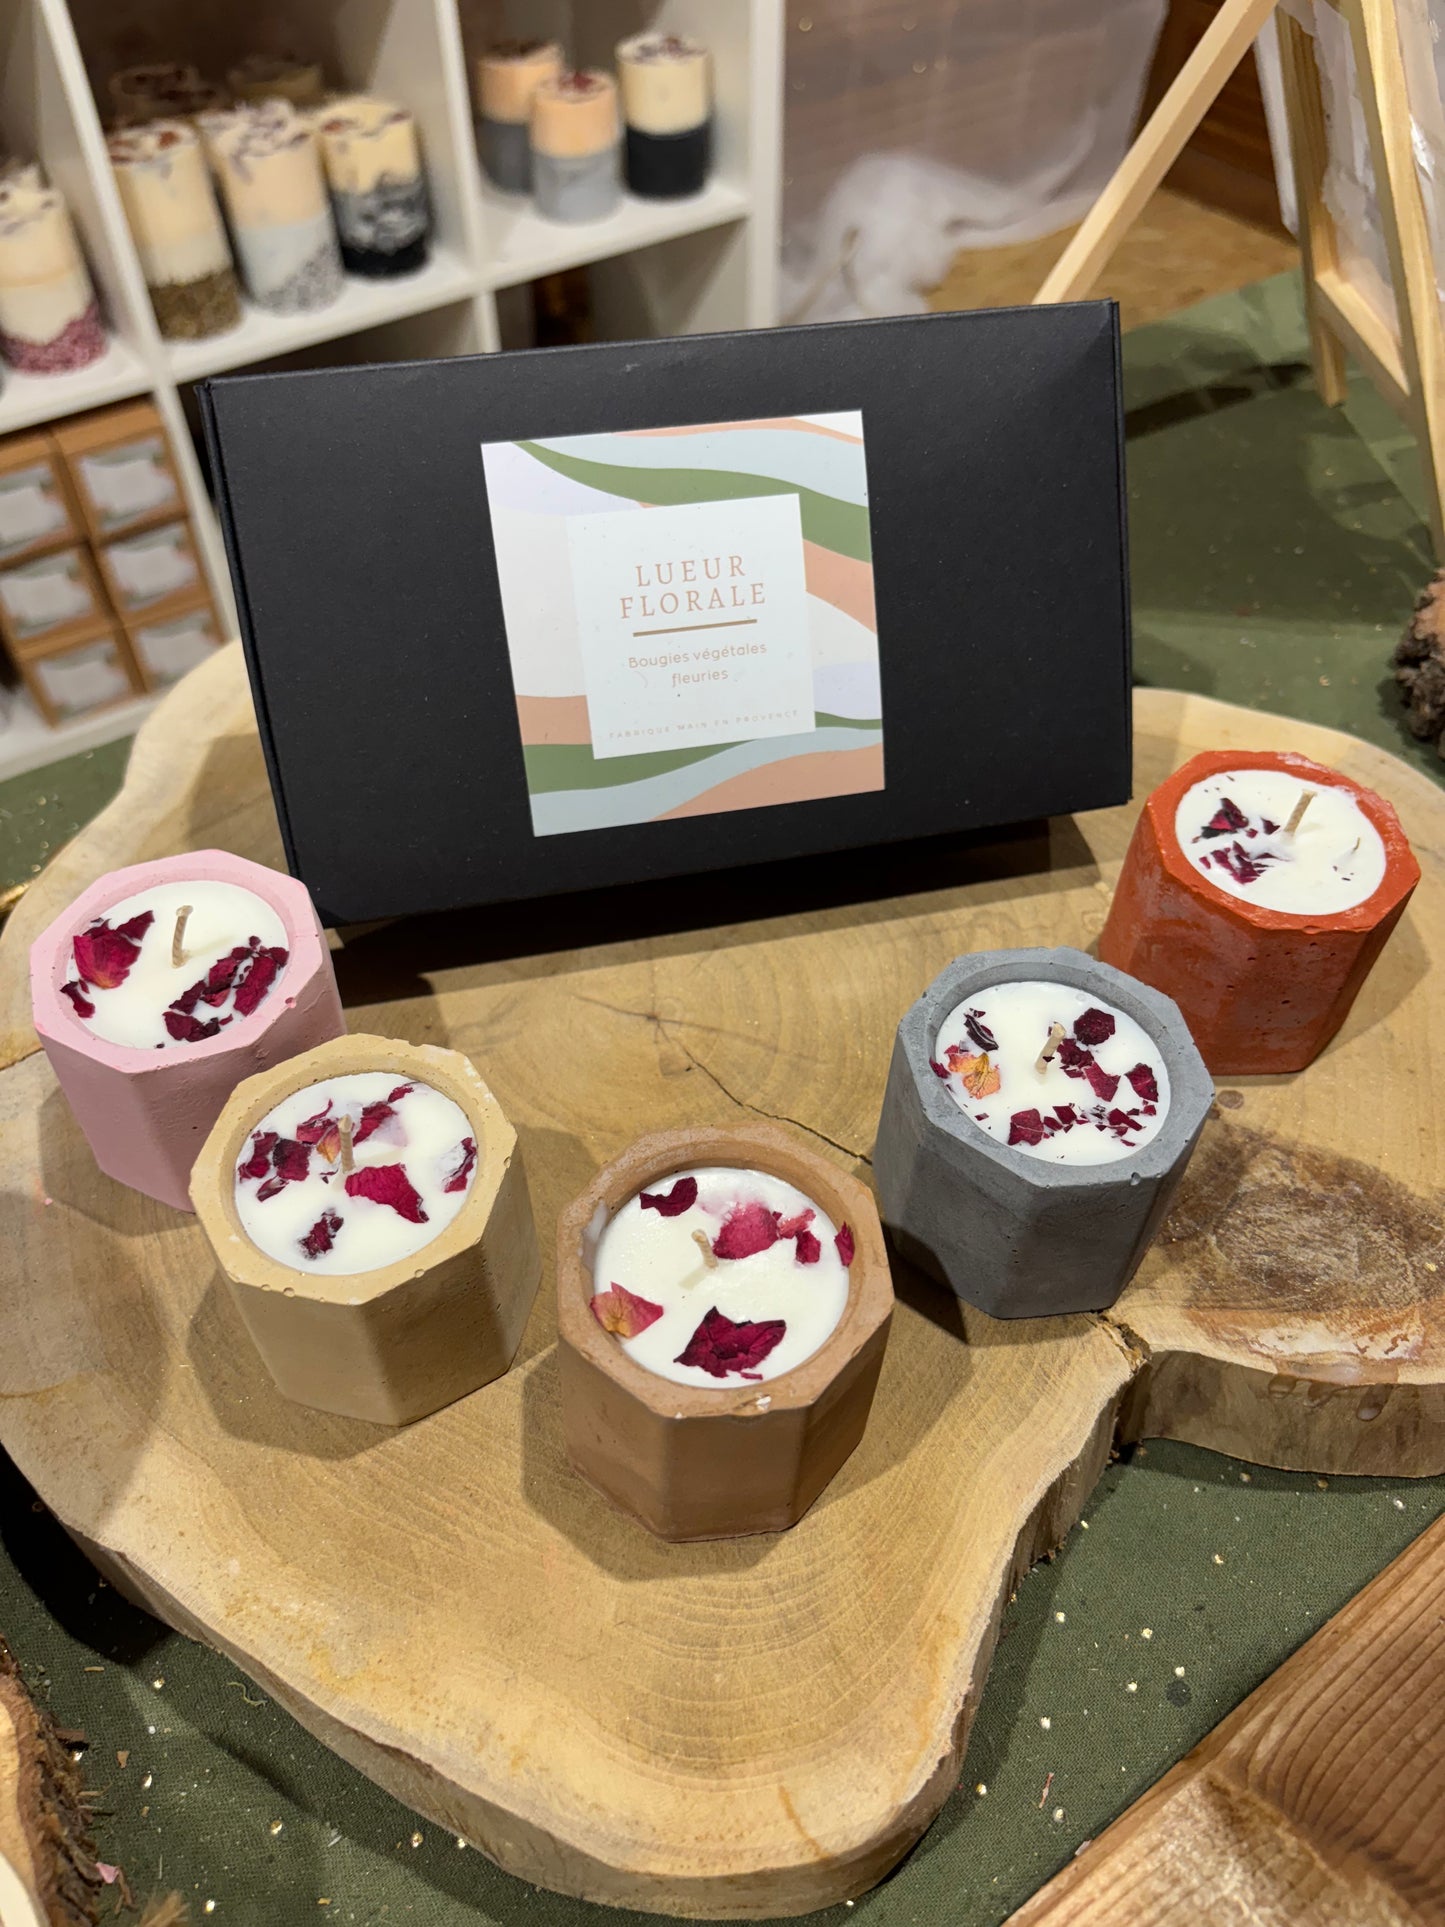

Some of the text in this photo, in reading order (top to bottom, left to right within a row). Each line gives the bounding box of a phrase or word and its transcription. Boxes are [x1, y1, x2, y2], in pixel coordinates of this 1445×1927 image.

[635, 555, 746, 587] LUEUR
[620, 583, 766, 619] FLORALE
[628, 643, 767, 668] Bougies végétales
[671, 669, 729, 688] fleuries
[677, 722, 707, 730] MAIN
[714, 719, 728, 727] EN
